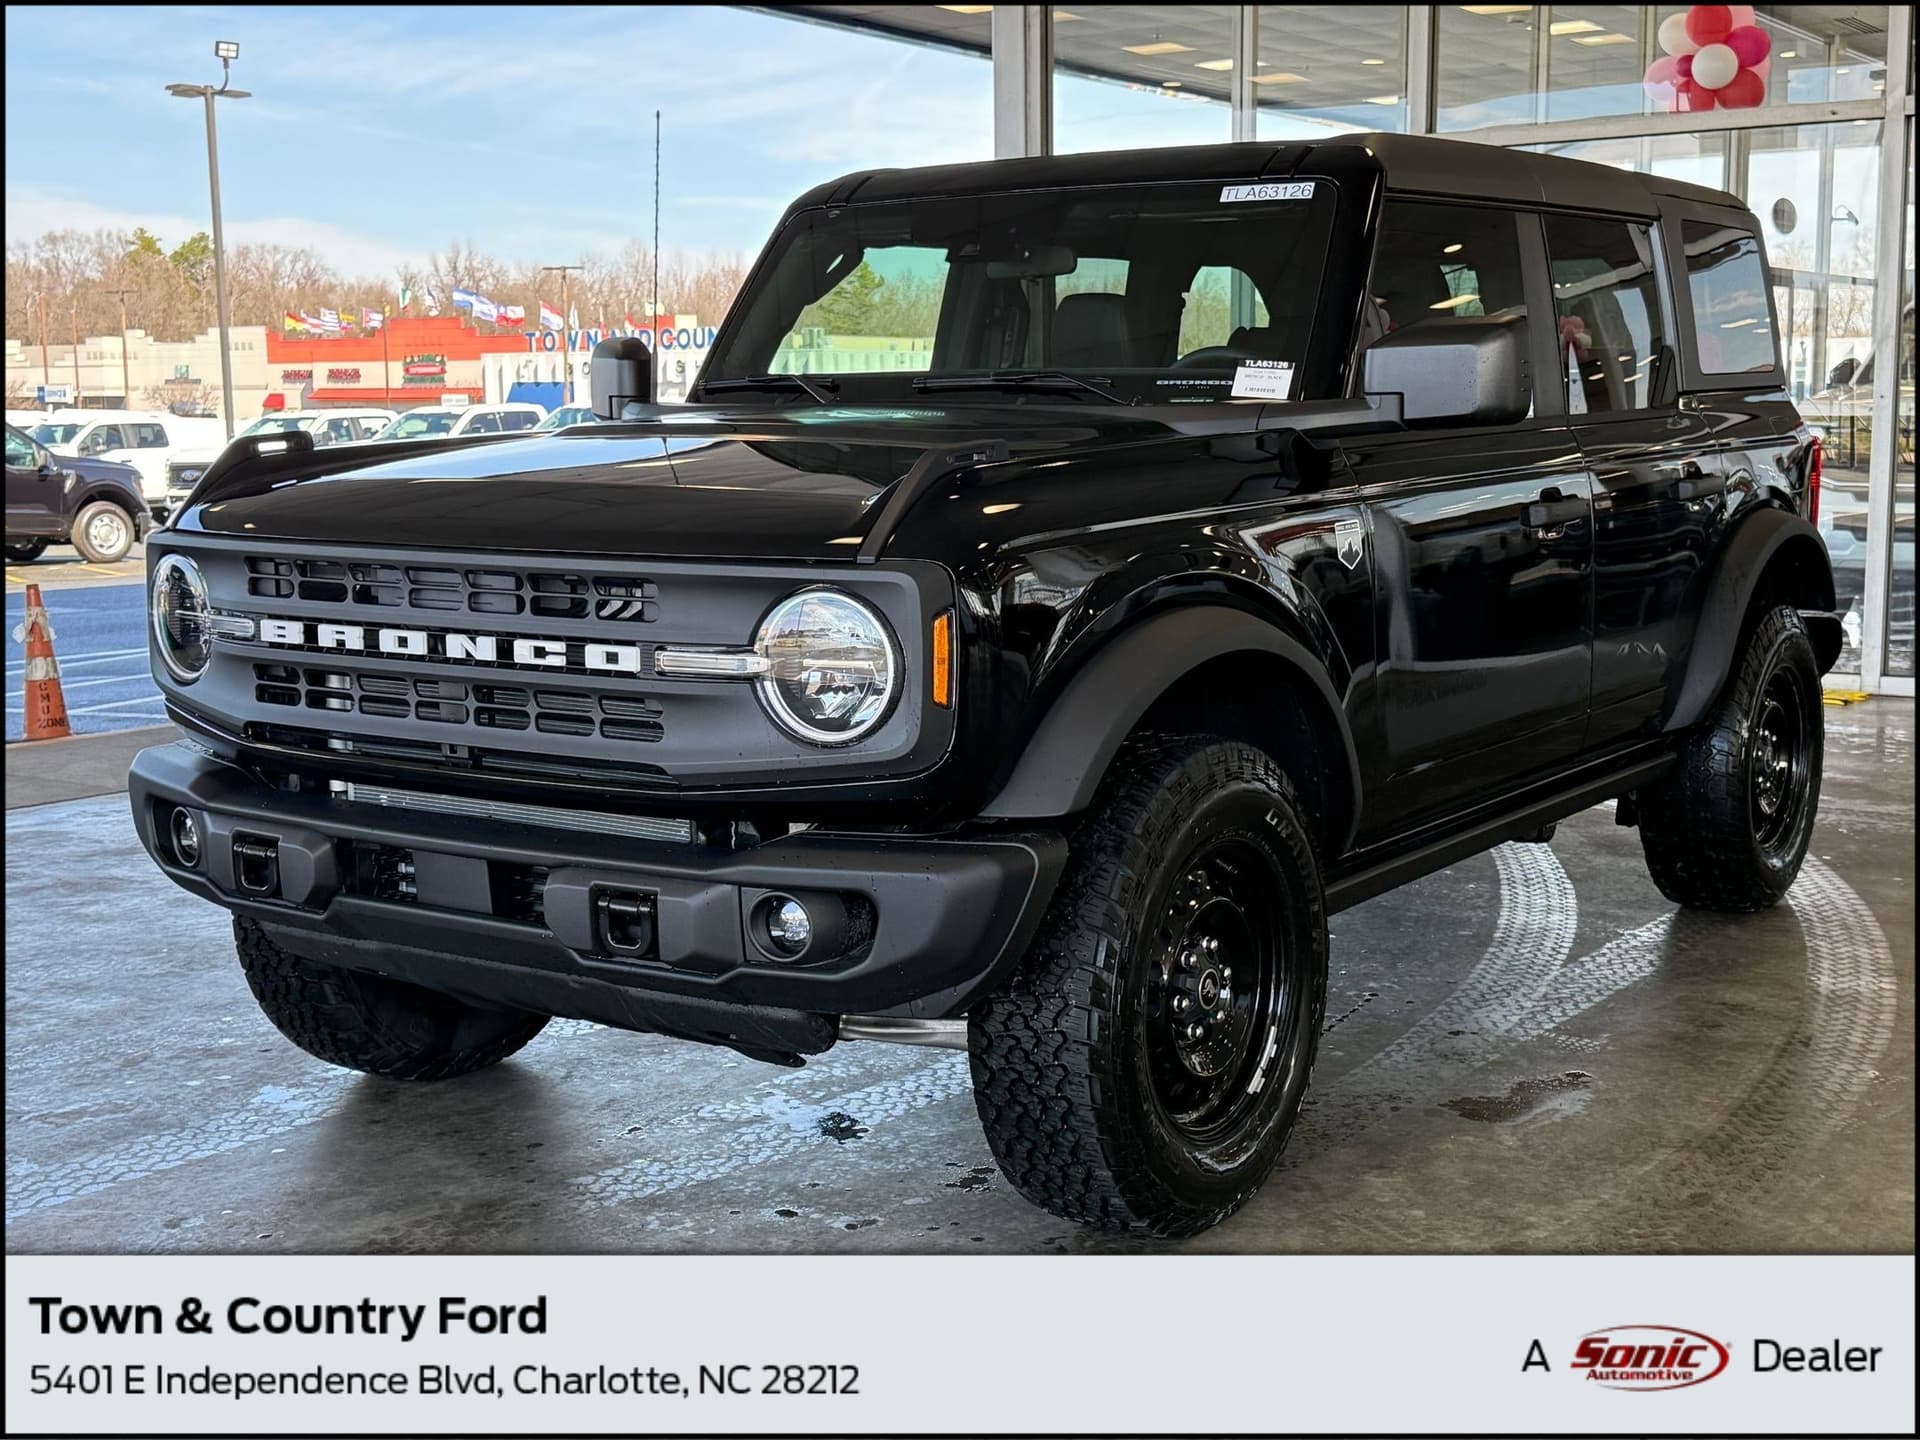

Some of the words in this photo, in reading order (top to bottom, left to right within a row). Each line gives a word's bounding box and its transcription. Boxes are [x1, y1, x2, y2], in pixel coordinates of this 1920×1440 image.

[1224, 184, 1313, 201] TLA63126
[1245, 359, 1289, 369] TLA63126
[260, 618, 641, 674] BRONCO
